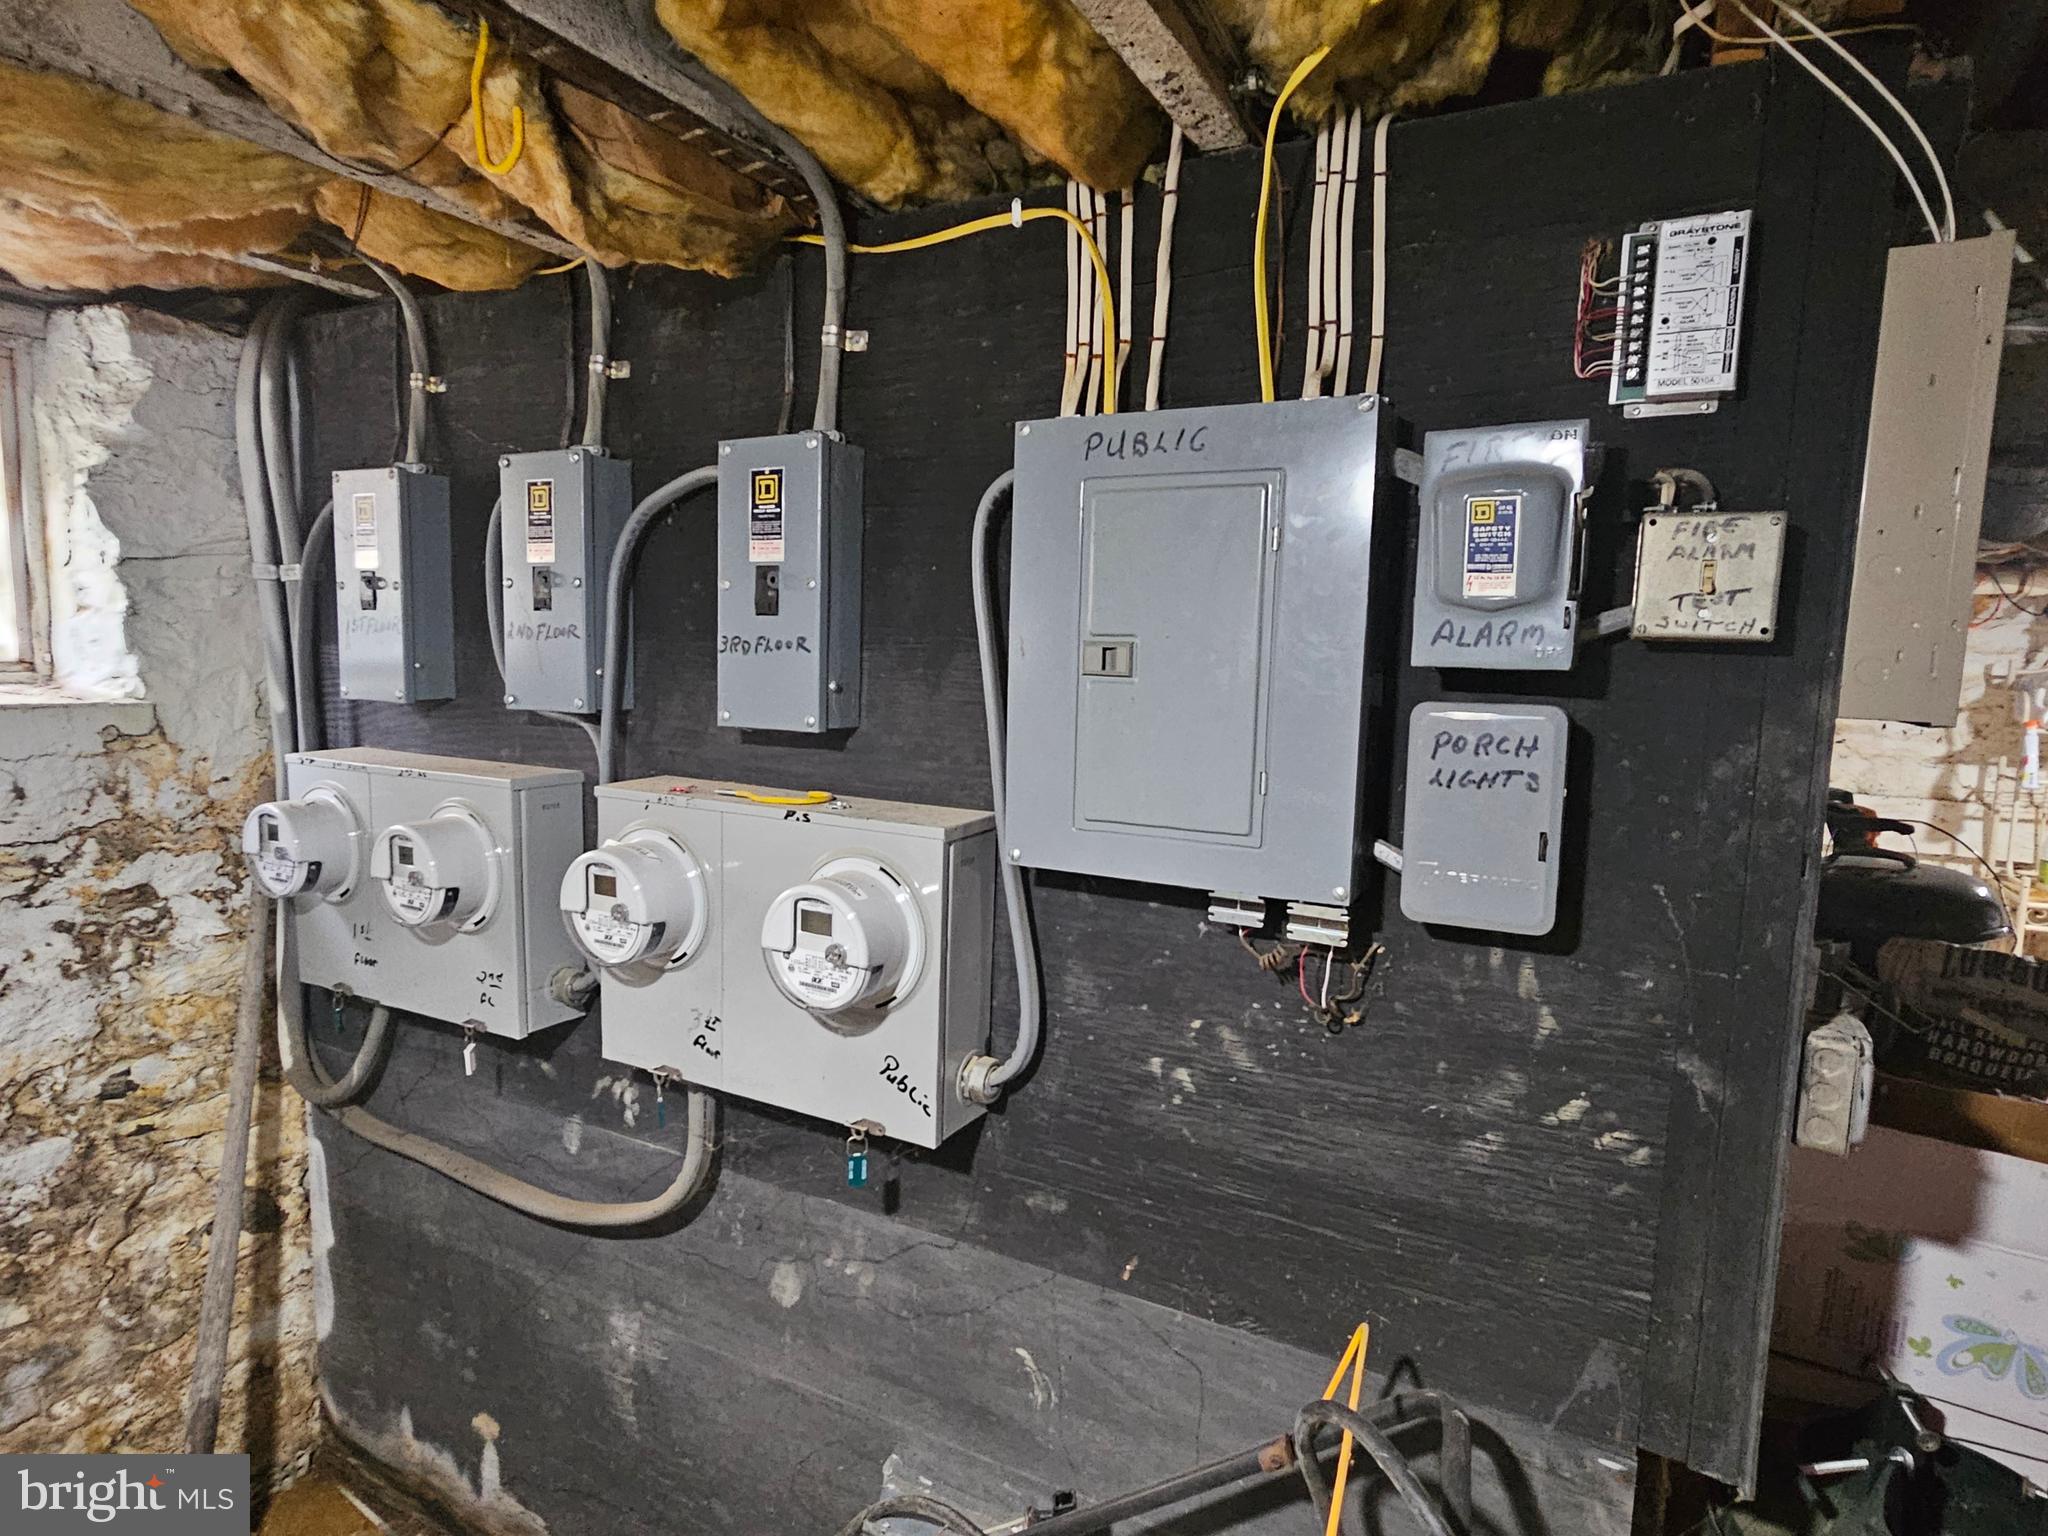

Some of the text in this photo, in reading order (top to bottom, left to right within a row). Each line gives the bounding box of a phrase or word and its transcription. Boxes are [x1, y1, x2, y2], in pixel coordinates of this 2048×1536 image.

[1669, 222, 1742, 238] GRAYSTONE
[1084, 425, 1209, 461] PUBLIC
[1550, 428, 1578, 441] ON
[1671, 516, 1752, 541] FIRE
[1666, 542, 1756, 562] ALARM
[1667, 587, 1753, 612] TEST
[535, 623, 581, 642] FLOOR
[1430, 618, 1545, 648] ALARM
[1655, 615, 1757, 635] SWITCH
[719, 635, 812, 655] 3RD FLOOR
[1430, 730, 1540, 760] PORCH
[1428, 768, 1541, 793] LIGHTS
[879, 1054, 931, 1117] Public
